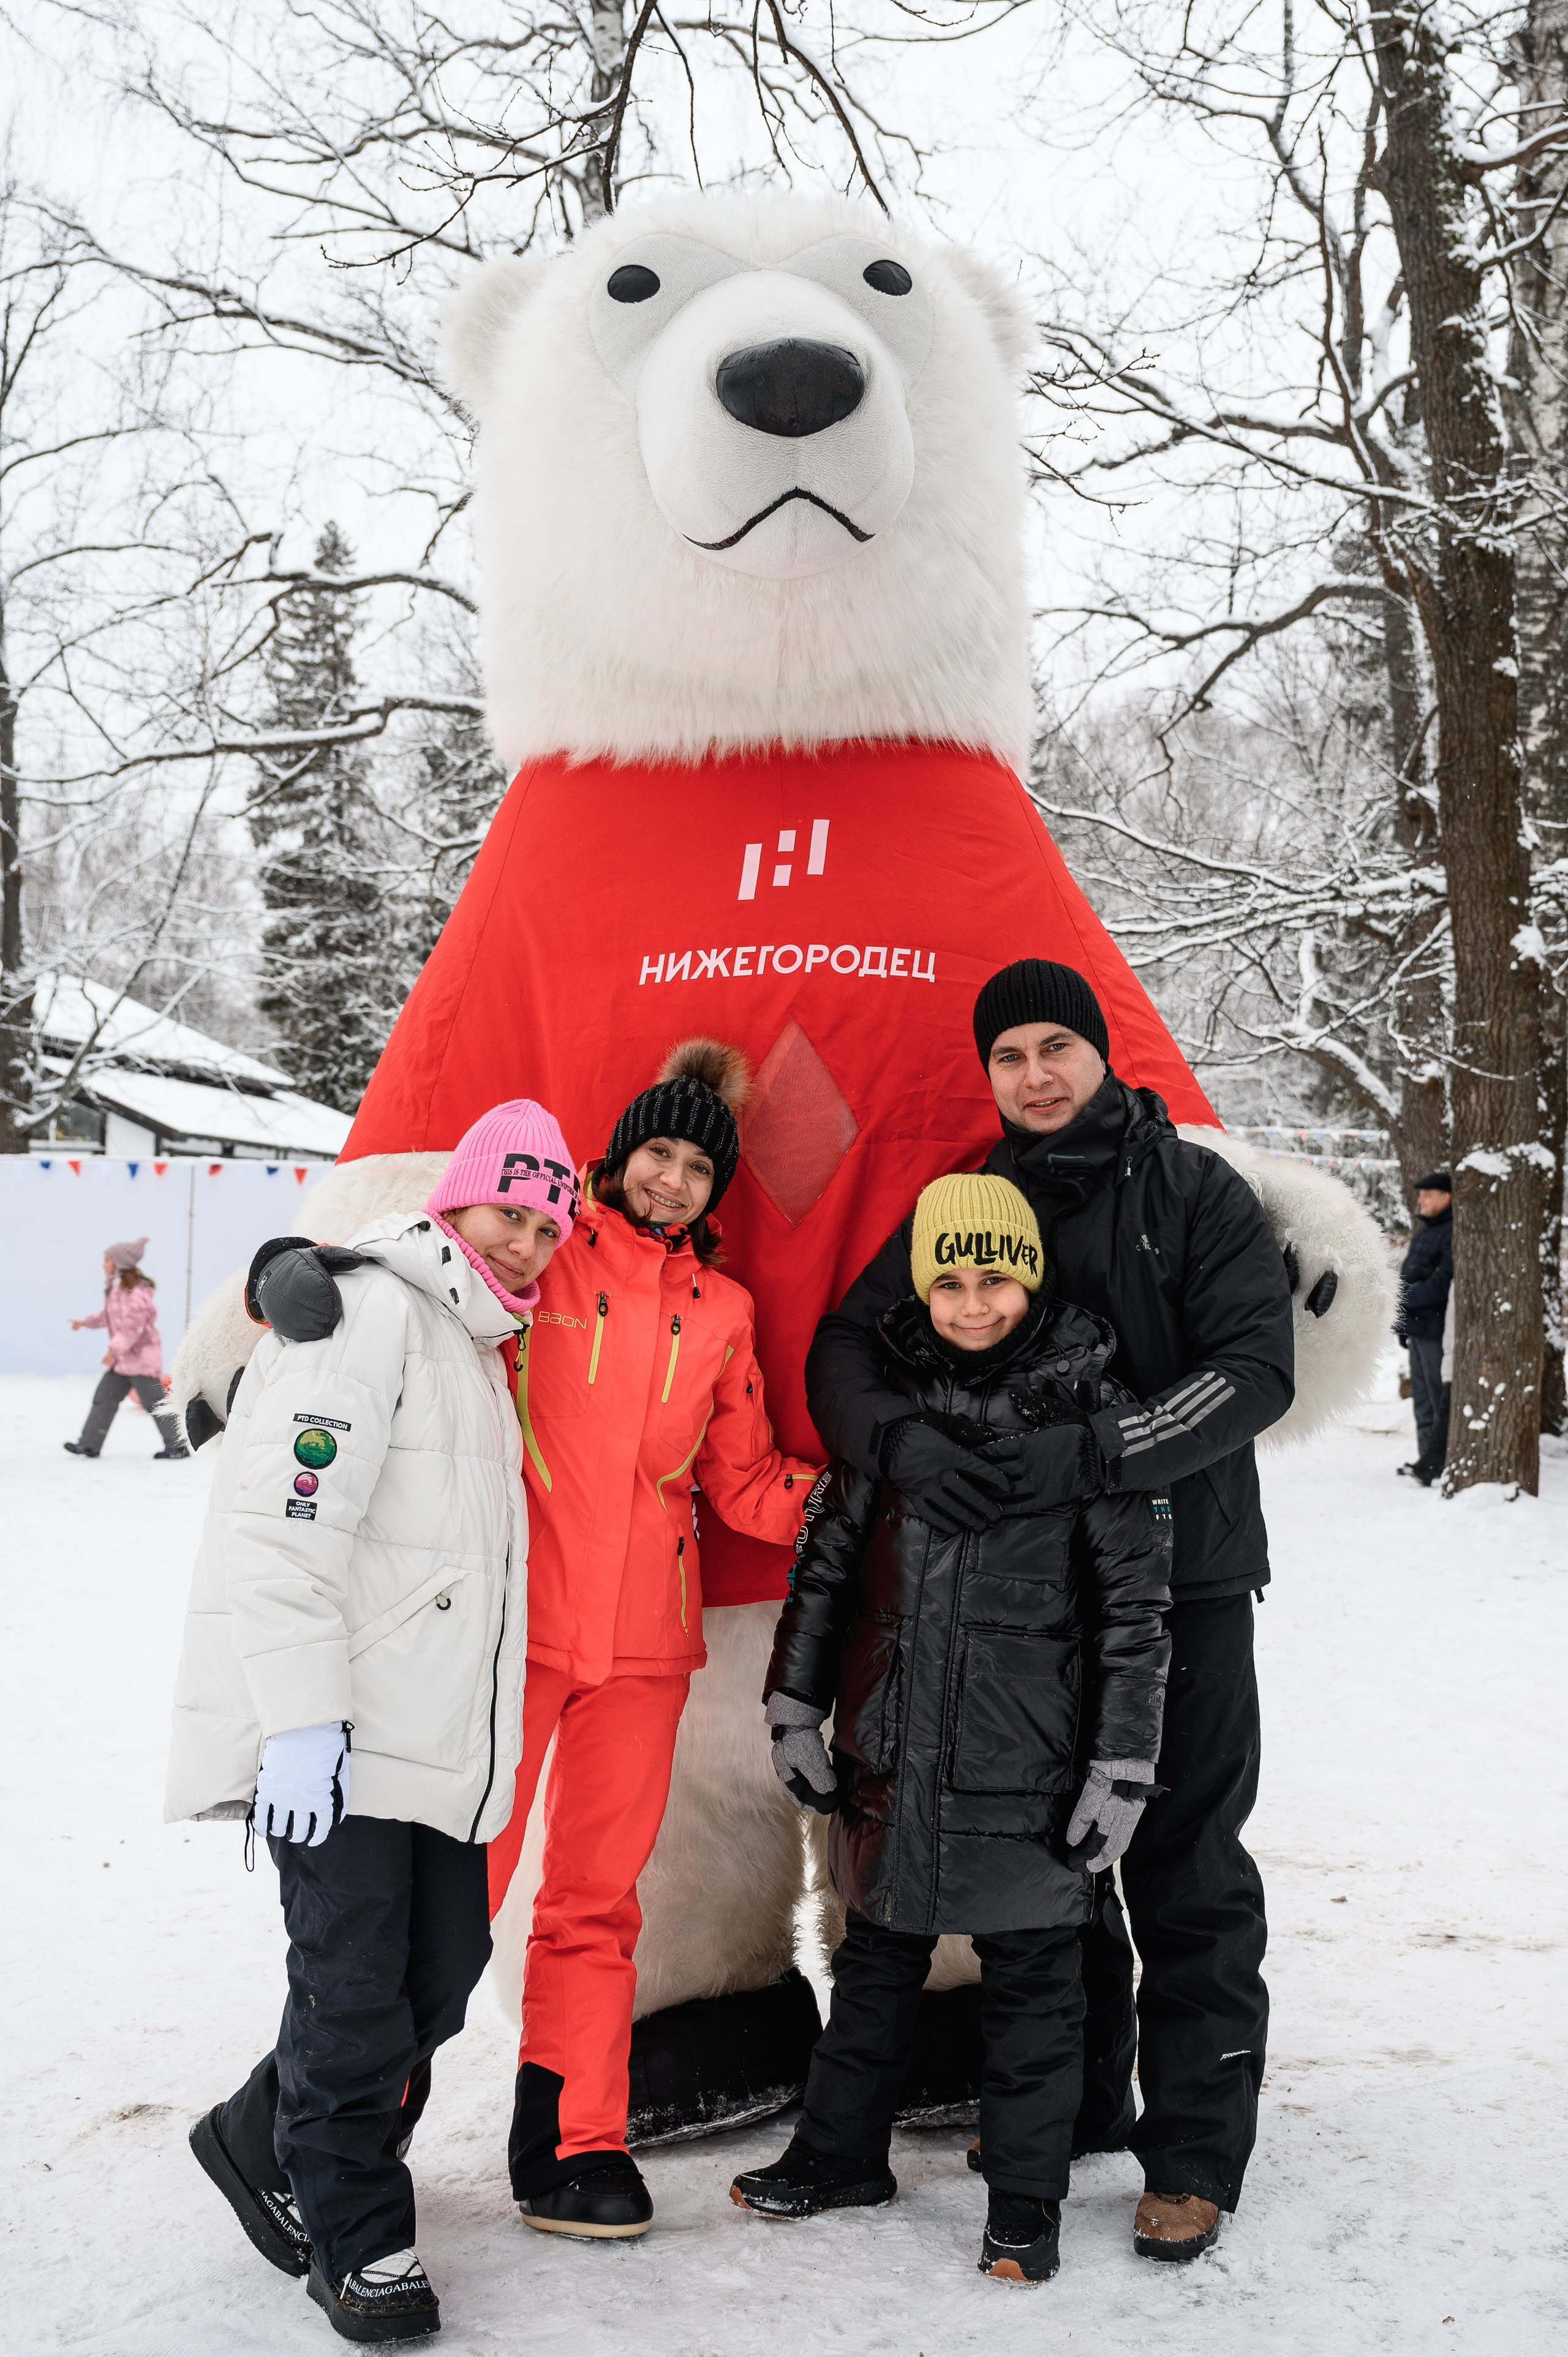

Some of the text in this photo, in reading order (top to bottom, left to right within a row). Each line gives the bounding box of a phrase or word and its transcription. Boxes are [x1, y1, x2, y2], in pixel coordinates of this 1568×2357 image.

[639, 944, 935, 985] НИЖЕГОРОДЕЦ
[532, 1172, 557, 1184] OFFICIAL
[935, 1231, 1038, 1278] GULLIVER
[310, 1417, 348, 1430] COLLECTION
